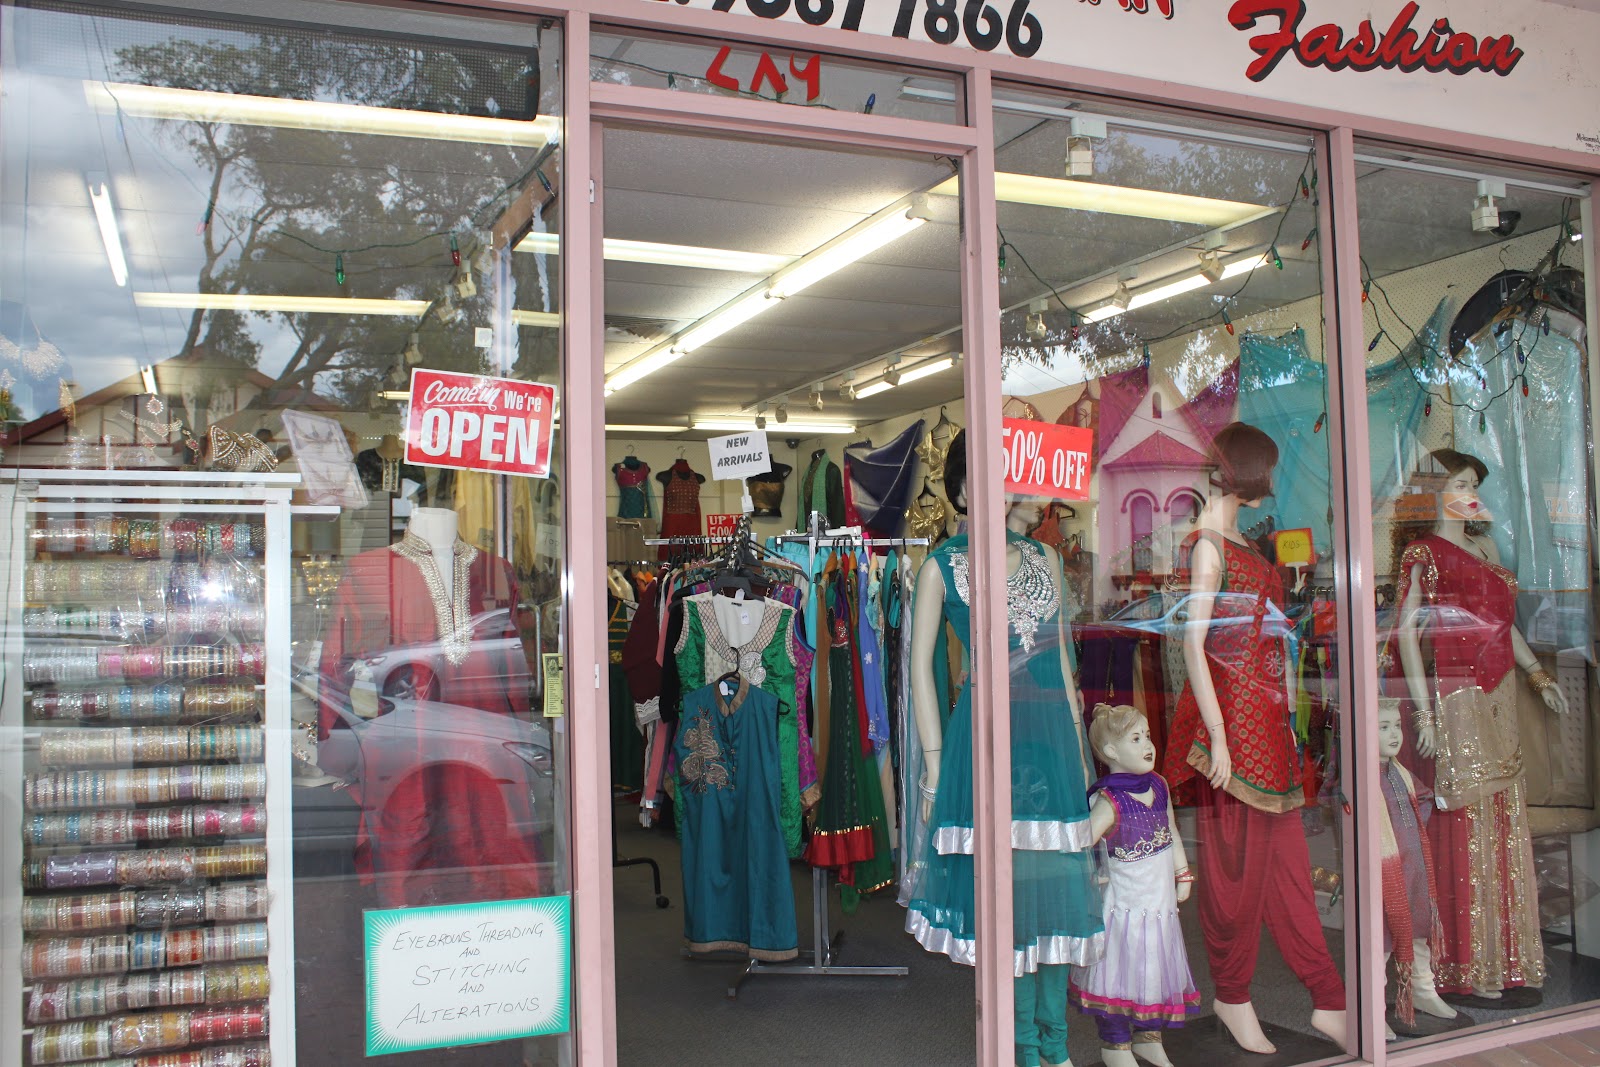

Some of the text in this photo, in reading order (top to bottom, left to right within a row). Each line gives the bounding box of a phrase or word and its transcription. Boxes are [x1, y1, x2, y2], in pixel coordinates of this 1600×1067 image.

[1228, 0, 1524, 82] Fashion
[424, 380, 477, 403] Come
[504, 390, 542, 412] We're
[420, 407, 540, 466] OPEN
[726, 436, 749, 449] NEW
[717, 451, 763, 467] ARRIVALS
[1052, 448, 1088, 490] OFF
[709, 515, 727, 525] UP
[1282, 540, 1301, 550] KIDS
[392, 921, 544, 951] EYEBROWS THREADING
[459, 946, 481, 958] AND
[412, 957, 530, 986] STITCHING
[458, 982, 485, 994] AND
